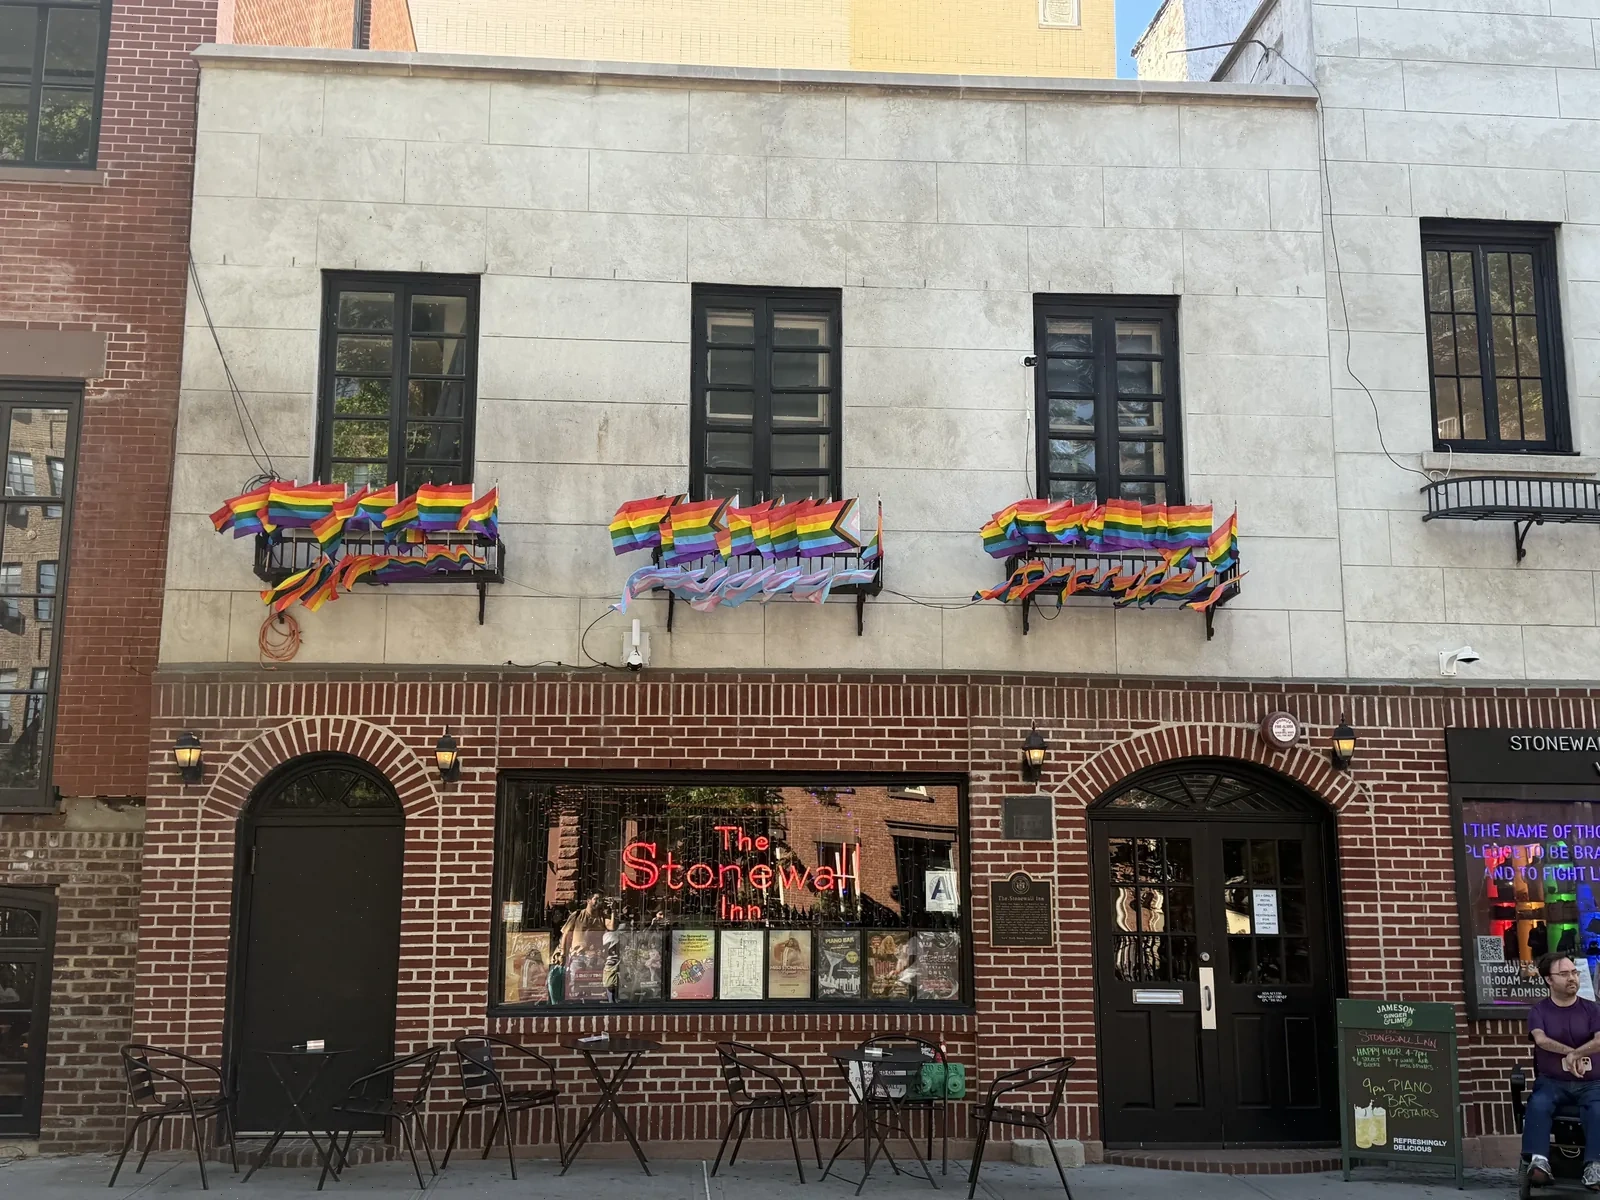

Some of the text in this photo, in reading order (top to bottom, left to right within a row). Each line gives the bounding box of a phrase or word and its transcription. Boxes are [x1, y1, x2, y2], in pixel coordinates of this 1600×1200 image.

[1510, 735, 1600, 751] STONEWA
[714, 825, 769, 851] The
[1470, 823, 1500, 838] THE
[1506, 824, 1548, 838] NAME
[1552, 824, 1572, 839] OF
[1550, 845, 1568, 859] BE
[620, 841, 861, 891] Stonewall
[1484, 866, 1515, 880] AND
[1518, 866, 1538, 880] TO
[1543, 866, 1586, 880] FIGHT
[930, 876, 952, 900] A
[721, 894, 761, 921] Inn
[1480, 964, 1520, 974] Tuesday
[1482, 976, 1520, 985] 10:00AM
[1482, 988, 1508, 997] FREE
[1376, 1004, 1414, 1014] JAMESON
[1356, 1047, 1380, 1056] HAPPY
[1382, 1048, 1404, 1056] HOUR
[1388, 1078, 1432, 1094] PIANO
[1383, 1094, 1423, 1108] BAR
[1389, 1108, 1439, 1118] UPSTAIRS
[1394, 1138, 1447, 1147] REFRESHINGLY
[1394, 1144, 1432, 1152] DELICIOUS
